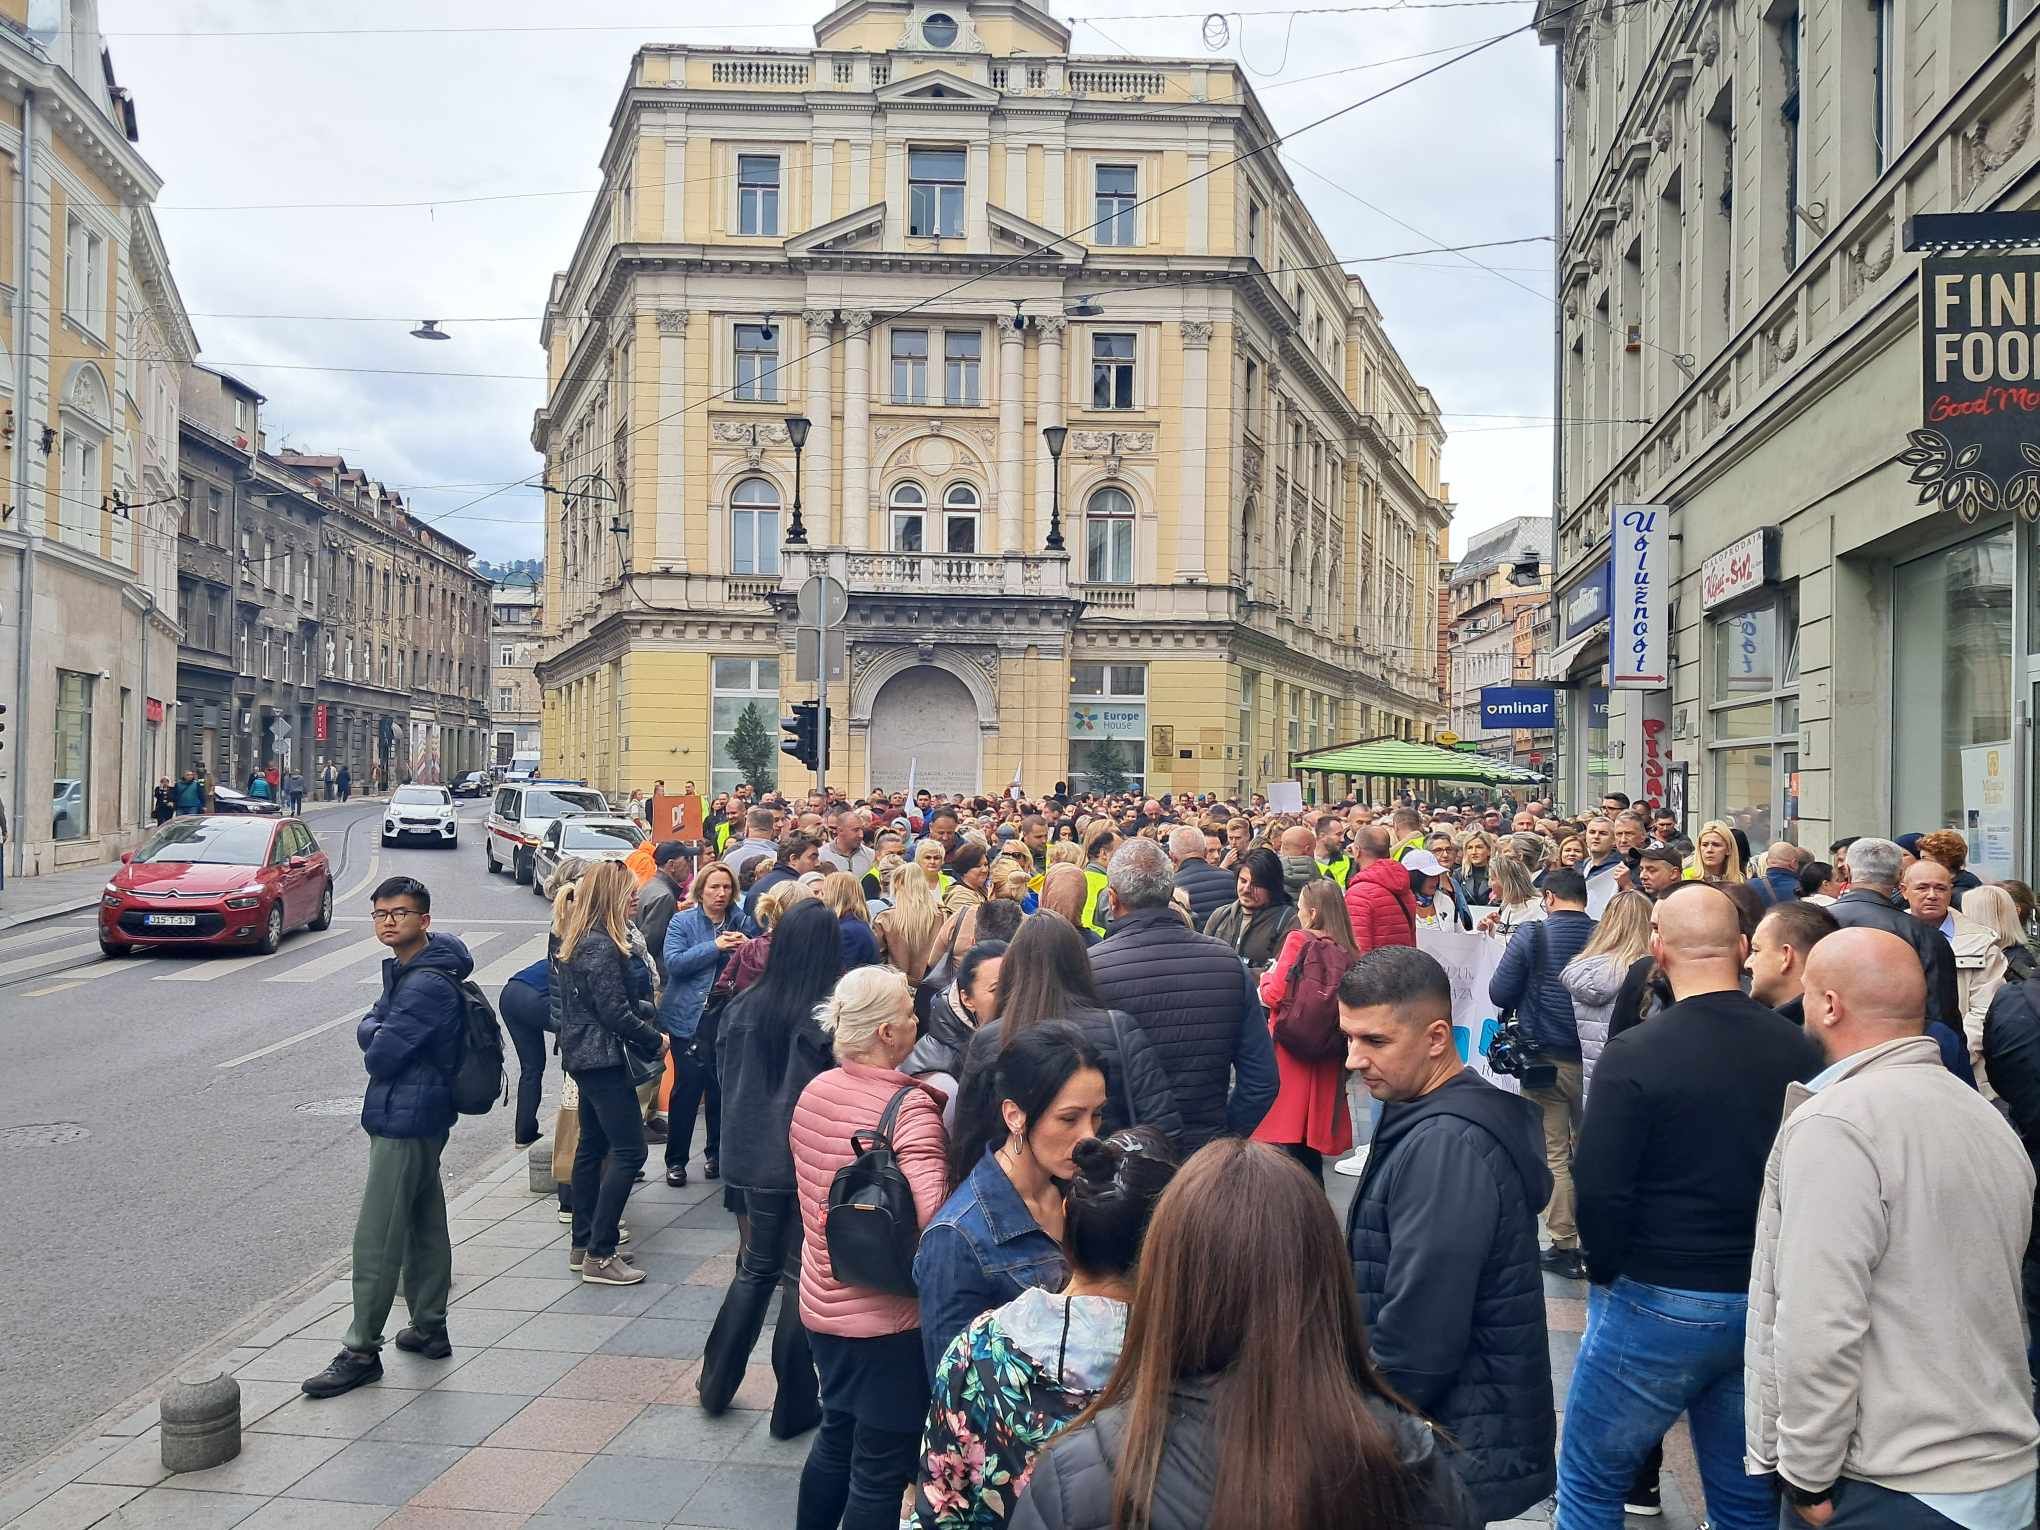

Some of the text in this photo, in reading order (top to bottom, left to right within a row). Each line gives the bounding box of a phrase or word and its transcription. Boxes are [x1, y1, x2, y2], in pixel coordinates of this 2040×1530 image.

[1929, 385, 1993, 422] Good
[1623, 511, 1656, 673] Uslužnost
[1498, 701, 1549, 714] mlinar
[1103, 711, 1140, 721] Europe
[1103, 721, 1133, 730] House
